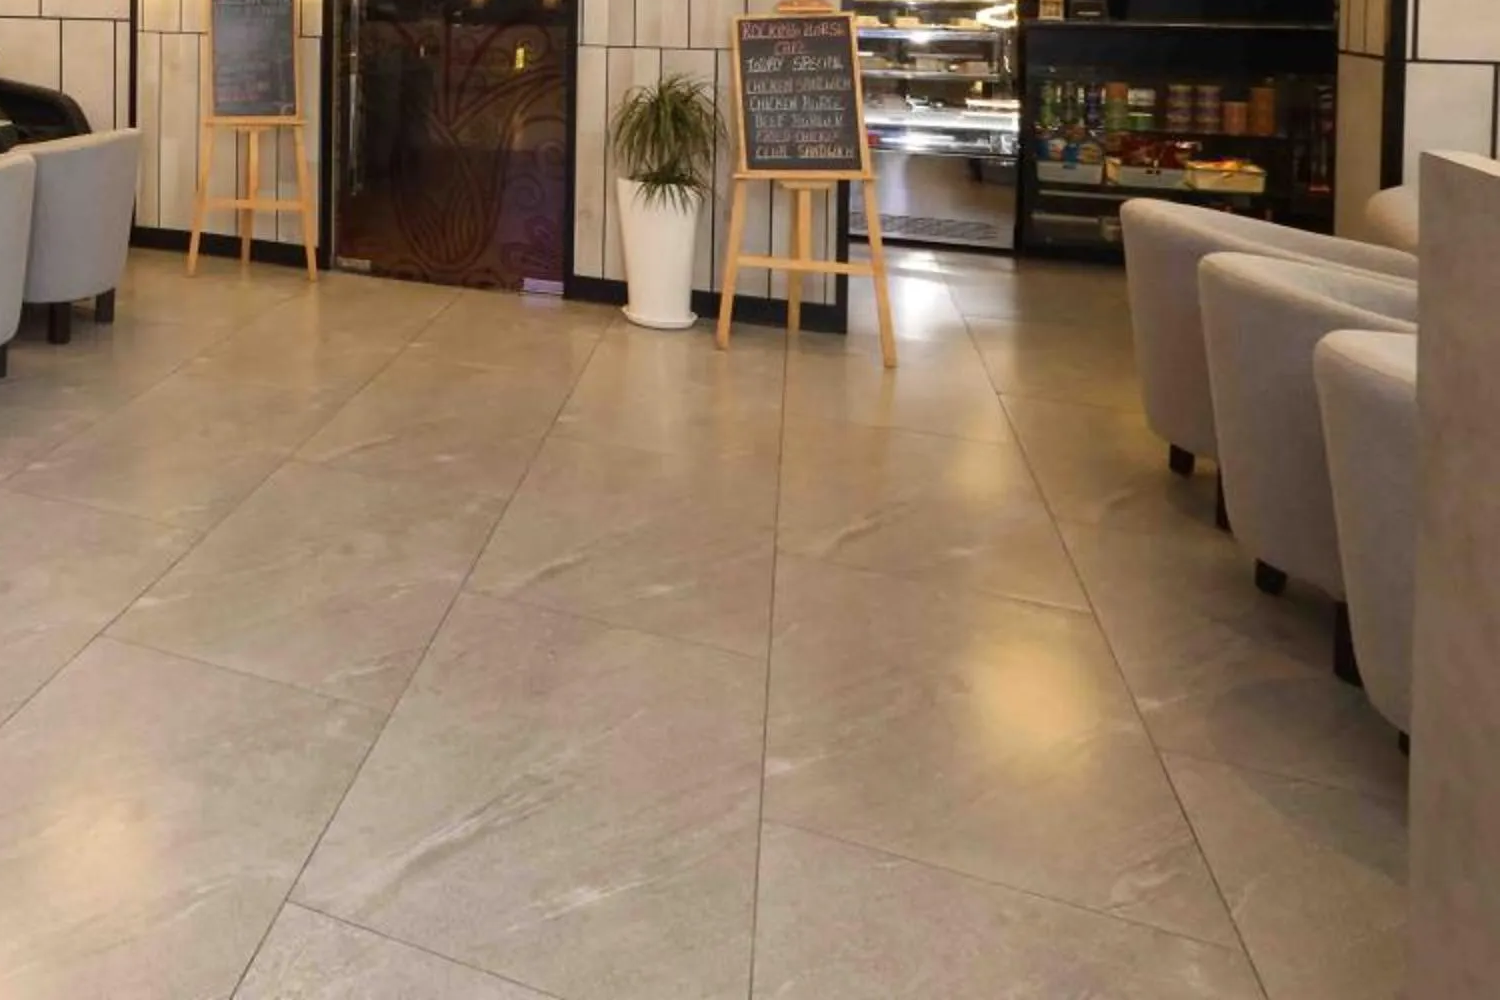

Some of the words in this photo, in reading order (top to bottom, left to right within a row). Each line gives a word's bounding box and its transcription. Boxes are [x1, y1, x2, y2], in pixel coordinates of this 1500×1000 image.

[747, 56, 783, 73] TODAY
[747, 77, 794, 94] CHICKEN
[748, 95, 798, 111] CHICKEN
